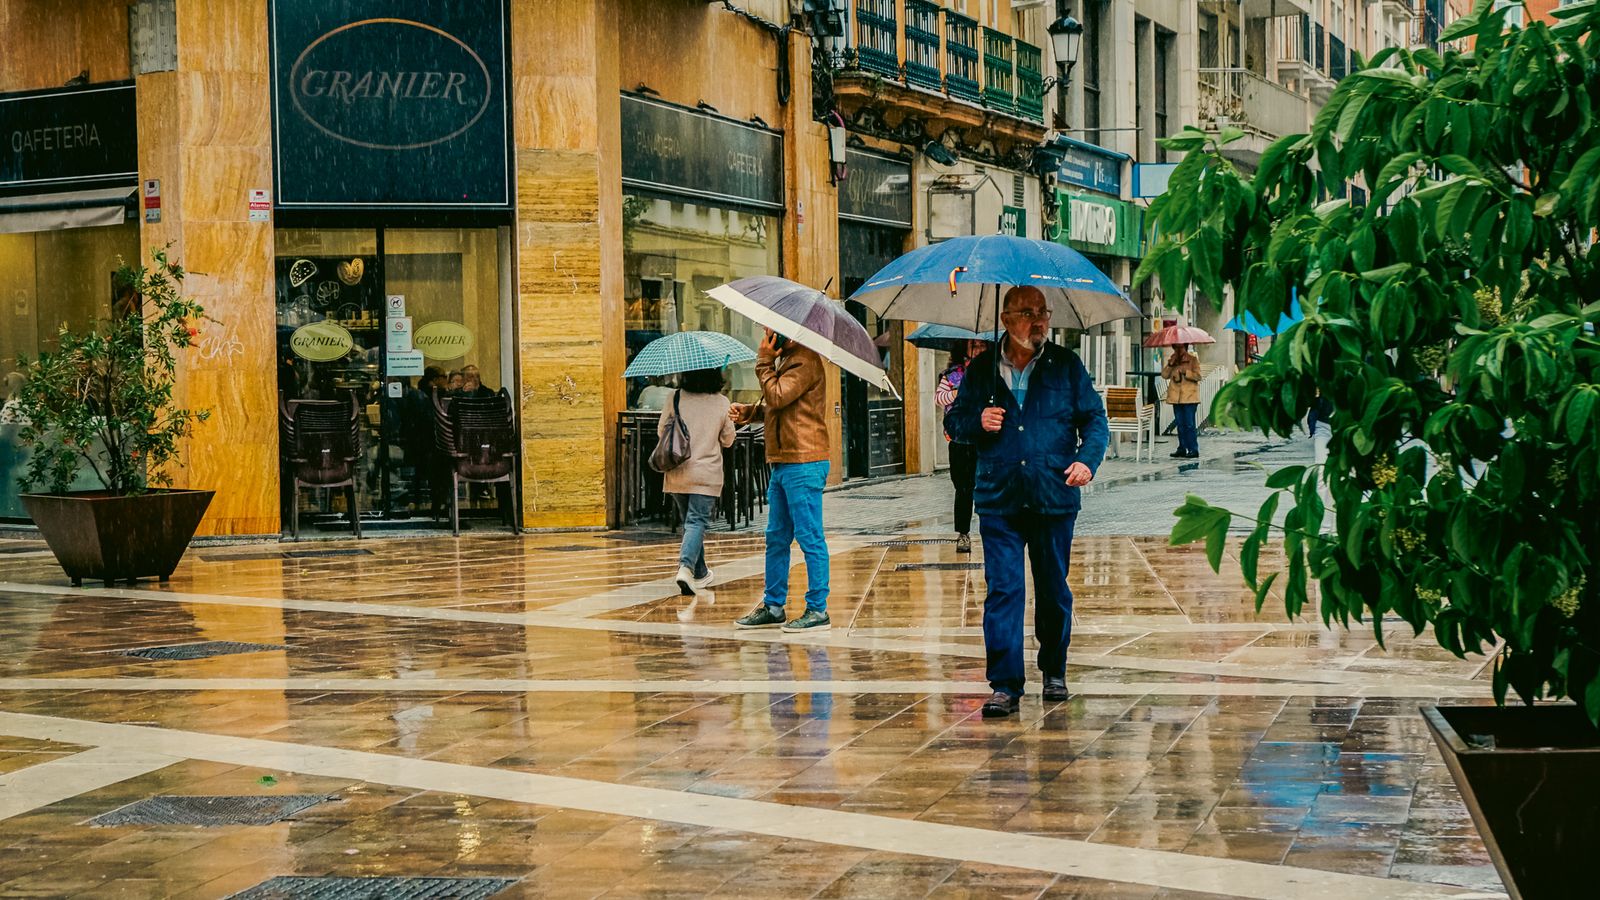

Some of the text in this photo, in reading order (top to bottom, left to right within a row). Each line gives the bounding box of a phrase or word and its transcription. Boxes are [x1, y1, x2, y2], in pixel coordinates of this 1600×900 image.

[301, 70, 467, 105] GRANIER
[293, 336, 348, 348] GRANIER
[415, 335, 466, 346] GRANIER
